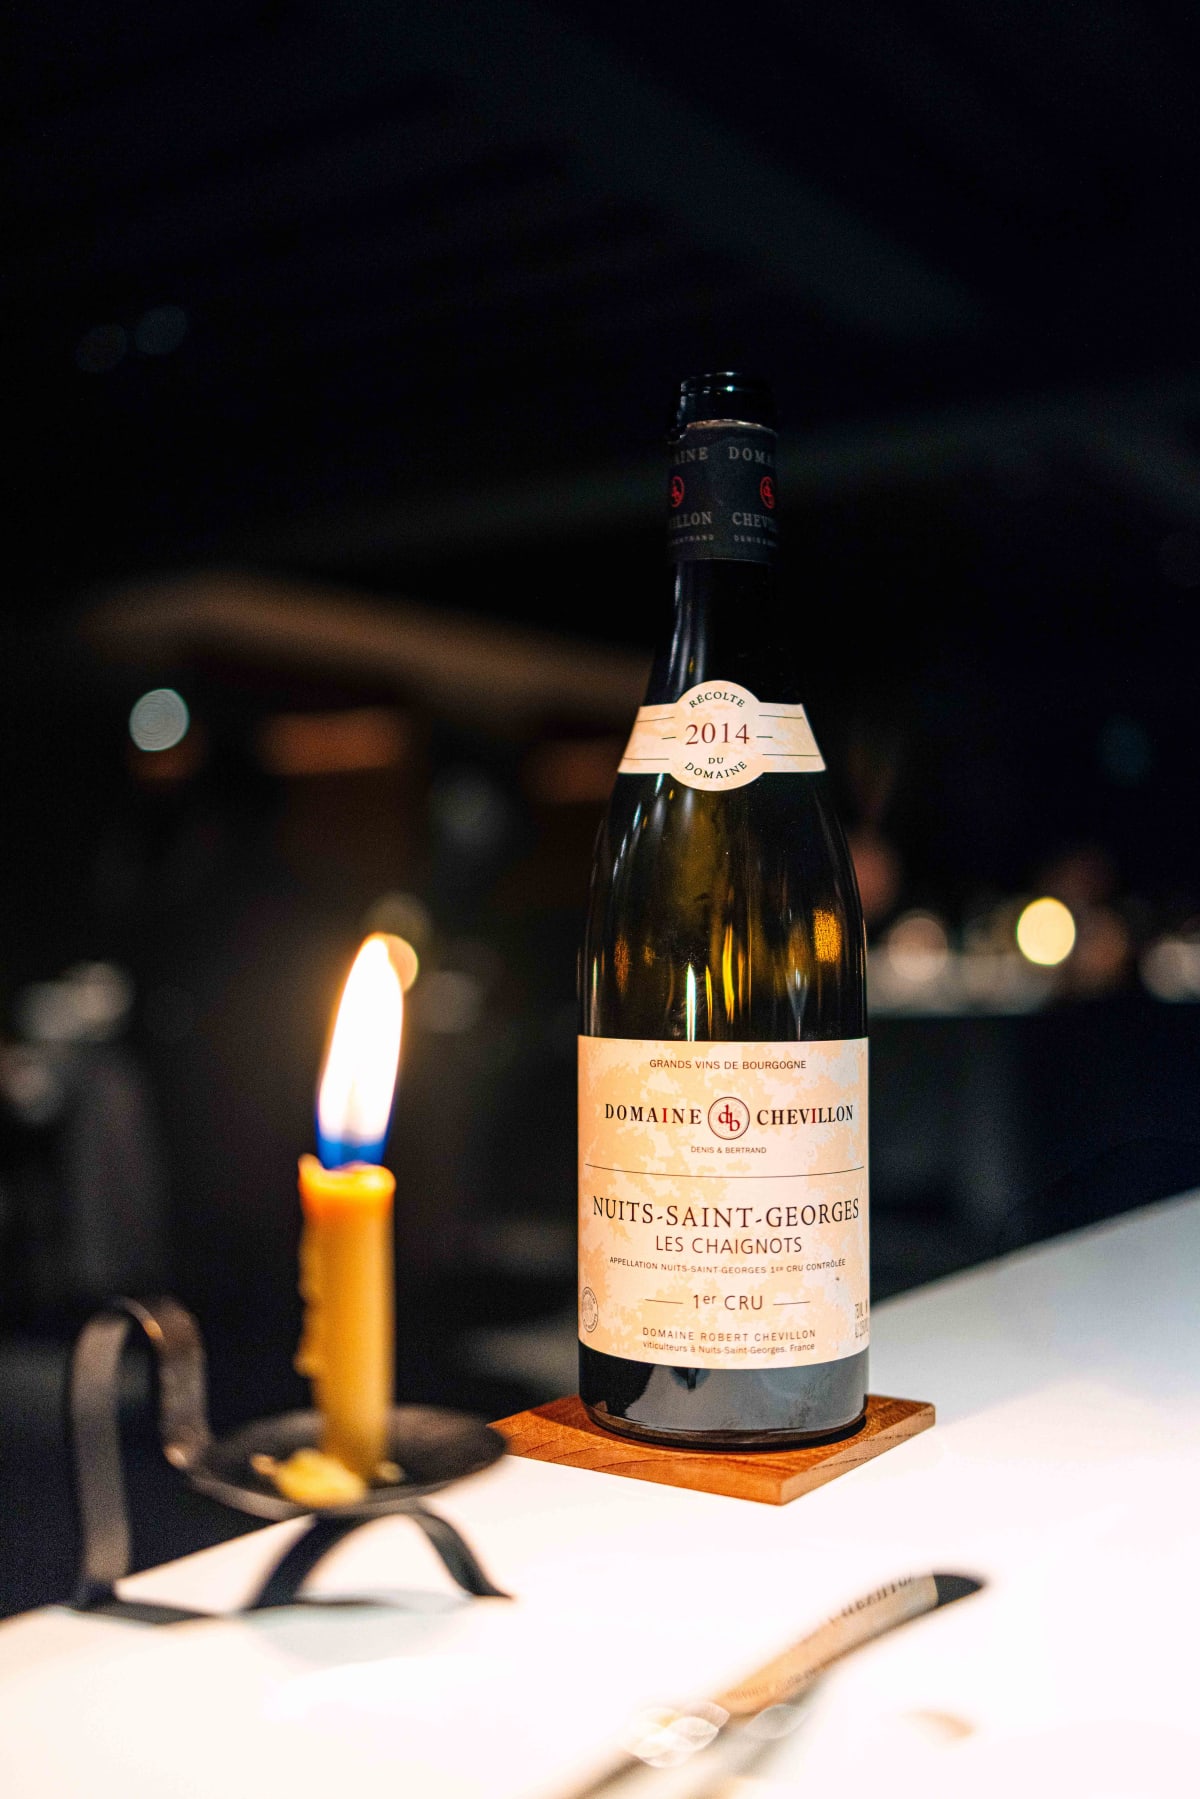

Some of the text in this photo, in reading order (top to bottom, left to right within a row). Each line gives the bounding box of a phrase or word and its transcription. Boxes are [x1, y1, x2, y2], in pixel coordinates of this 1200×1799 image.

[689, 691, 746, 708] RÉCOLTE
[685, 722, 750, 745] 2014
[684, 761, 748, 779] DOMAINE
[650, 1059, 807, 1070] GRANDS VINS DE BOURGOGNE
[605, 1103, 702, 1125] DOMAINE
[756, 1104, 854, 1126] CHEVILLON
[691, 1146, 715, 1154] DENIS
[725, 1146, 767, 1154] BERTRAND
[592, 1195, 860, 1229] NUITS-SAINT-GEORGES
[656, 1235, 803, 1255] LES CHAIGNOTS
[609, 1256, 658, 1270] APPELLATION
[661, 1263, 767, 1274] NUITS-SAINT-GEORGES
[786, 1265, 804, 1273] CRU
[806, 1257, 846, 1271] CONTRÔLÉE
[693, 1294, 764, 1311] 1er CRU
[642, 1327, 816, 1342] DOMAINE ROBERT CHEVILLON
[643, 1341, 688, 1353] viticulteurs
[690, 1344, 696, 1353] à
[790, 1343, 815, 1352] France
